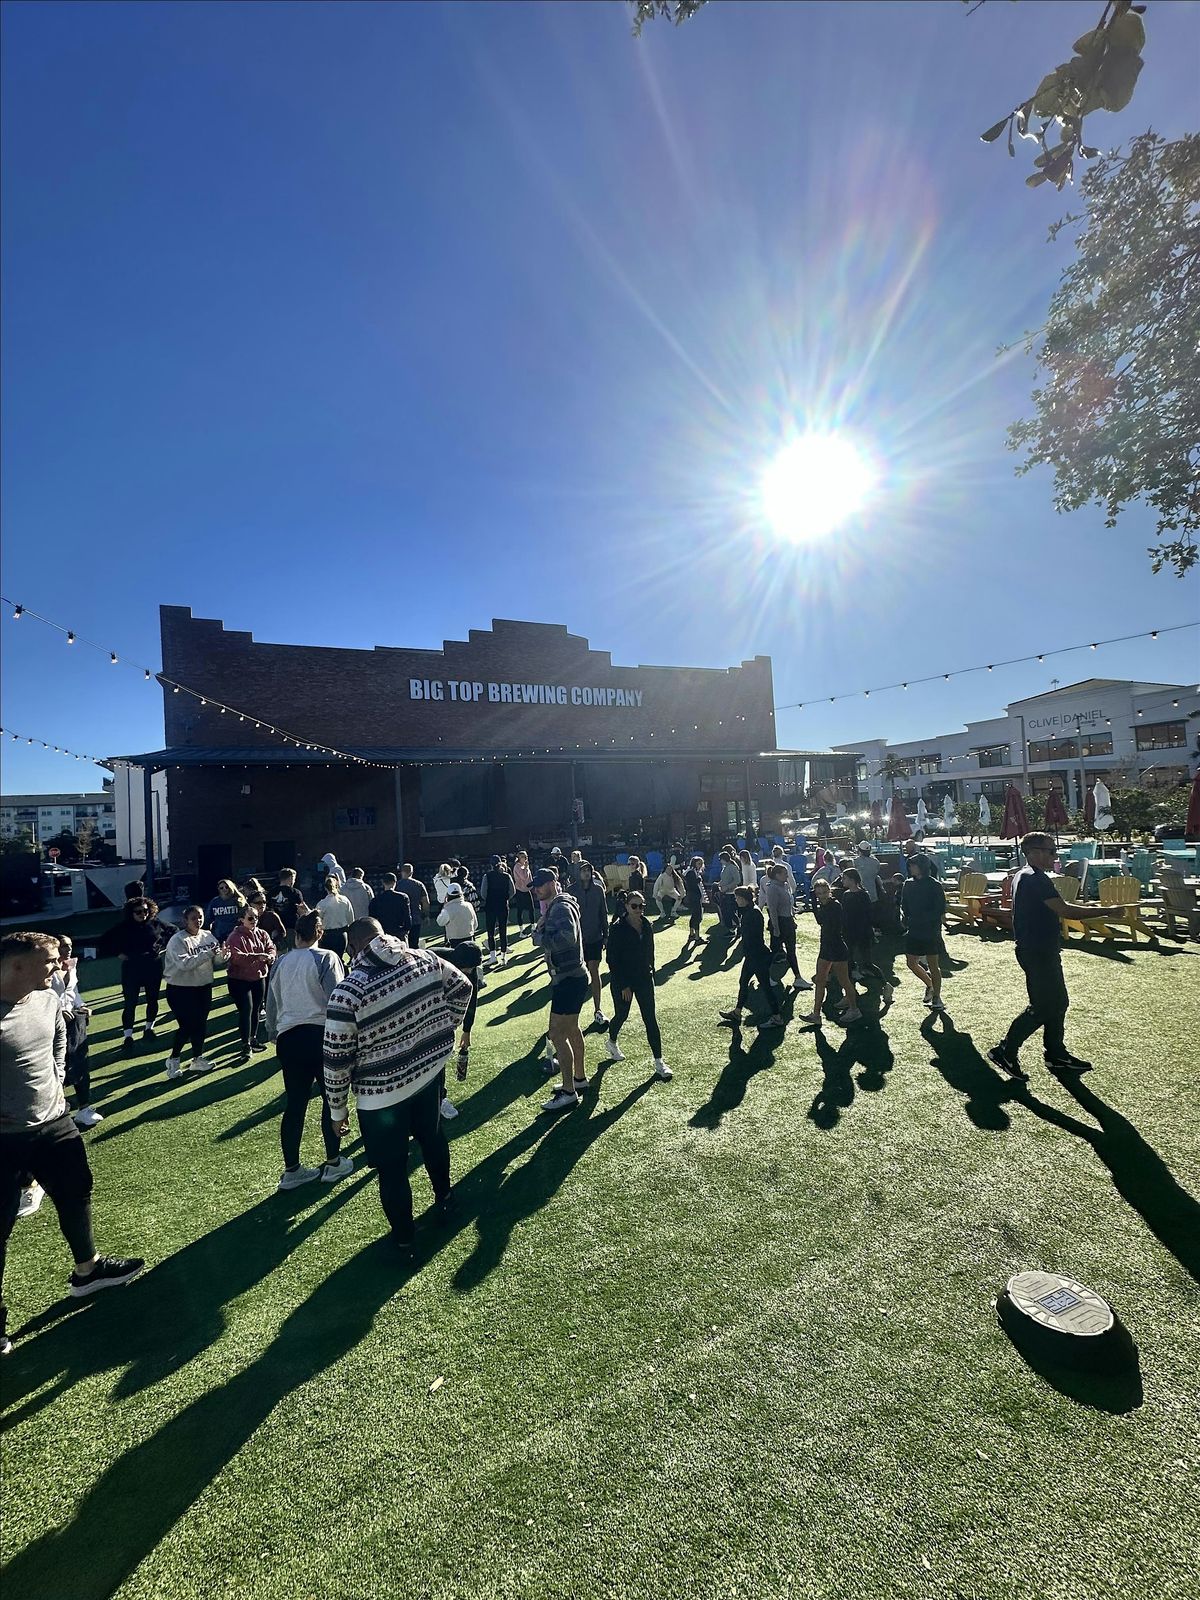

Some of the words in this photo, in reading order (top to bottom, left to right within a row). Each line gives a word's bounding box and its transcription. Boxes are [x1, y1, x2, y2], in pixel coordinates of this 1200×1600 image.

[409, 679, 444, 700] BIG
[447, 680, 484, 702] TOP
[488, 682, 568, 705] BREWING
[571, 686, 643, 707] COMPANY
